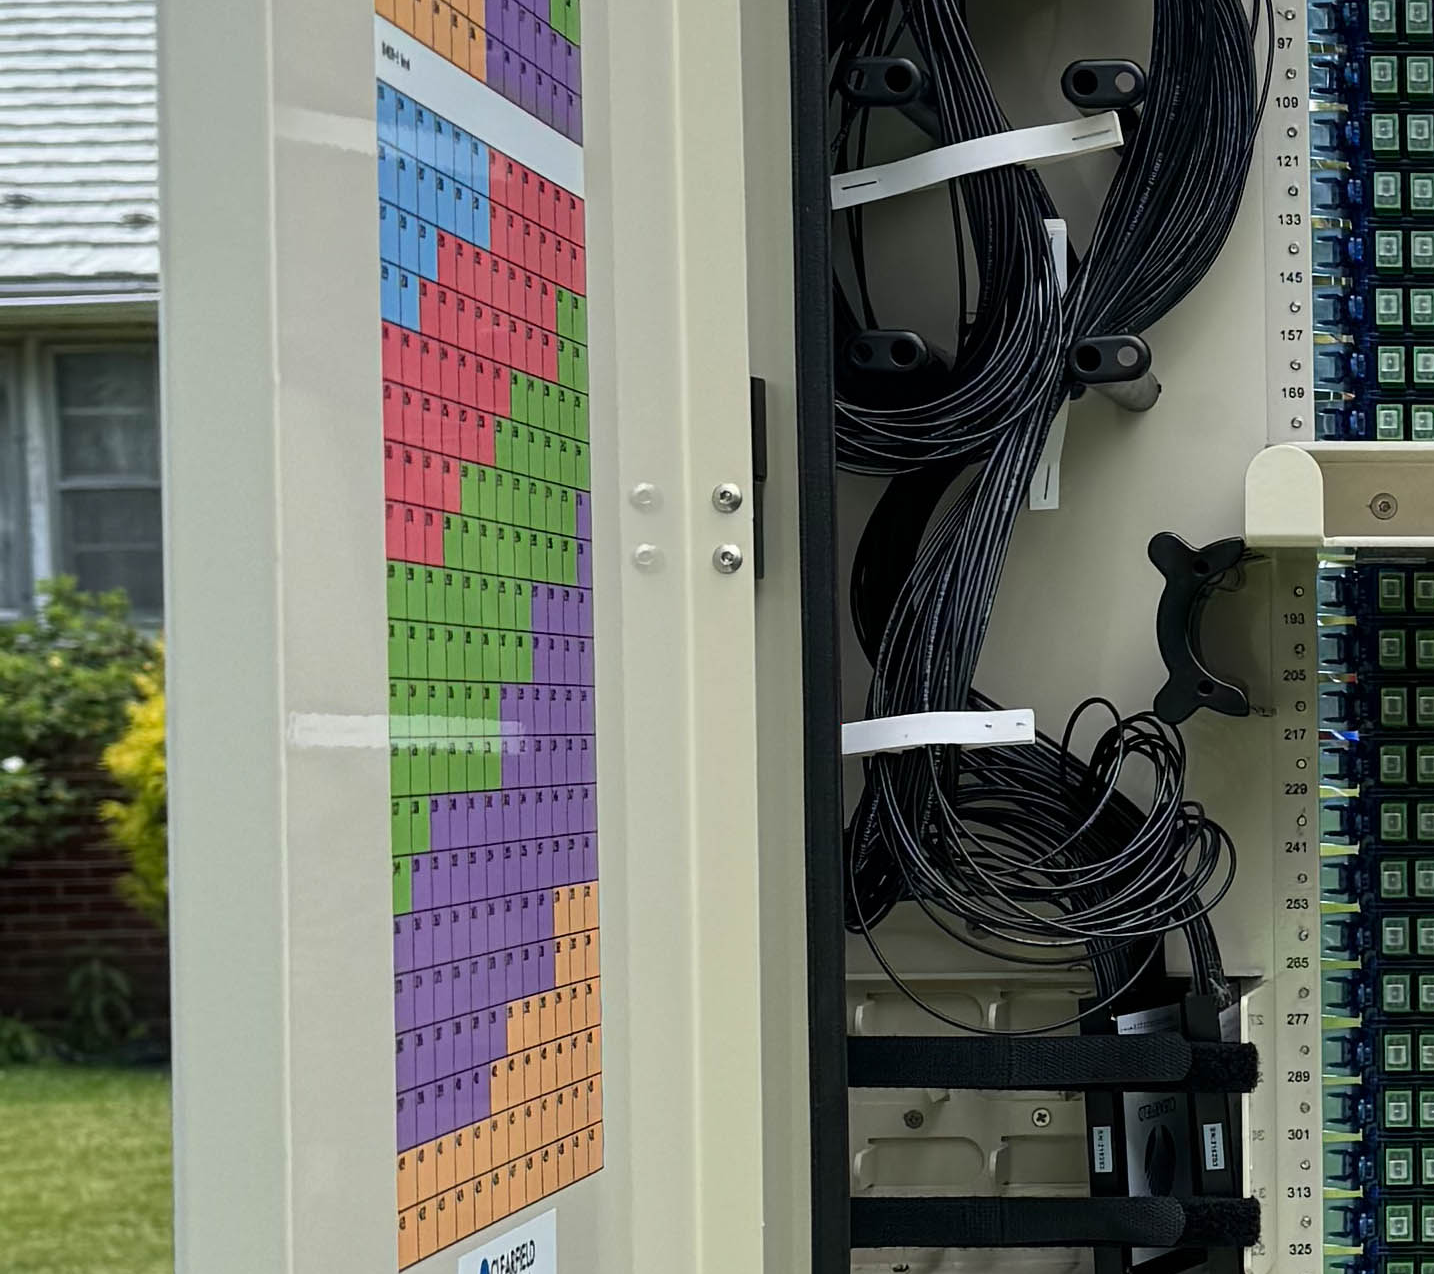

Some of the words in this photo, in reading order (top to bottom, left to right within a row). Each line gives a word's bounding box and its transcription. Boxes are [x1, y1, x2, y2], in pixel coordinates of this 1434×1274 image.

[1277, 37, 1293, 50] 97
[1275, 96, 1299, 109] 109
[1276, 155, 1299, 167] 121
[1278, 213, 1302, 226] 133
[1279, 271, 1303, 284] 145
[1280, 329, 1303, 341] 157
[1283, 612, 1305, 625] 193
[1284, 728, 1307, 741] 217
[1285, 841, 1307, 854] 241
[1285, 898, 1309, 910] 253
[1286, 1013, 1310, 1026] 277
[1287, 1070, 1311, 1083] 289
[1287, 1128, 1310, 1141] 301
[1287, 1186, 1312, 1199] 313
[1289, 1243, 1313, 1256] 325
